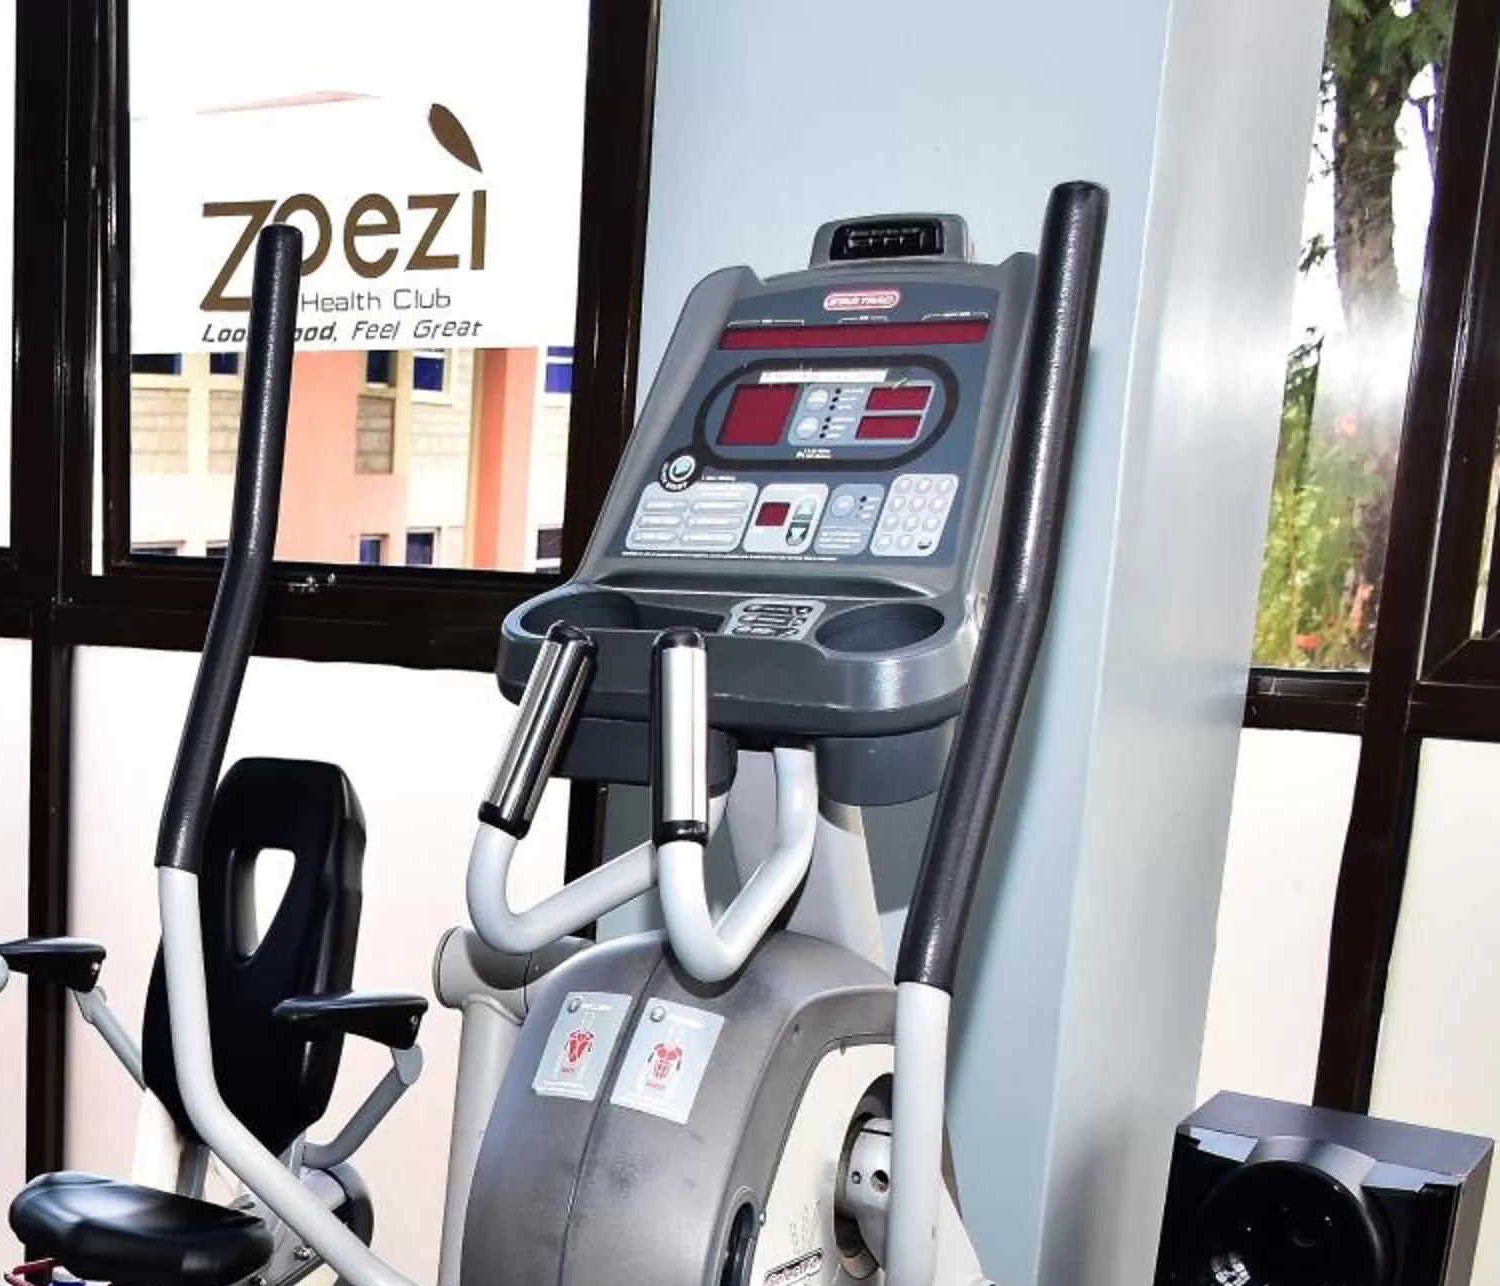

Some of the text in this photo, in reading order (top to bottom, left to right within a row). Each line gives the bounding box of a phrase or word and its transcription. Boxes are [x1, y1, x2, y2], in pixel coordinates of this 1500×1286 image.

[300, 287, 451, 313] Health Club
[202, 318, 484, 343] Loo ood, Feel Great
